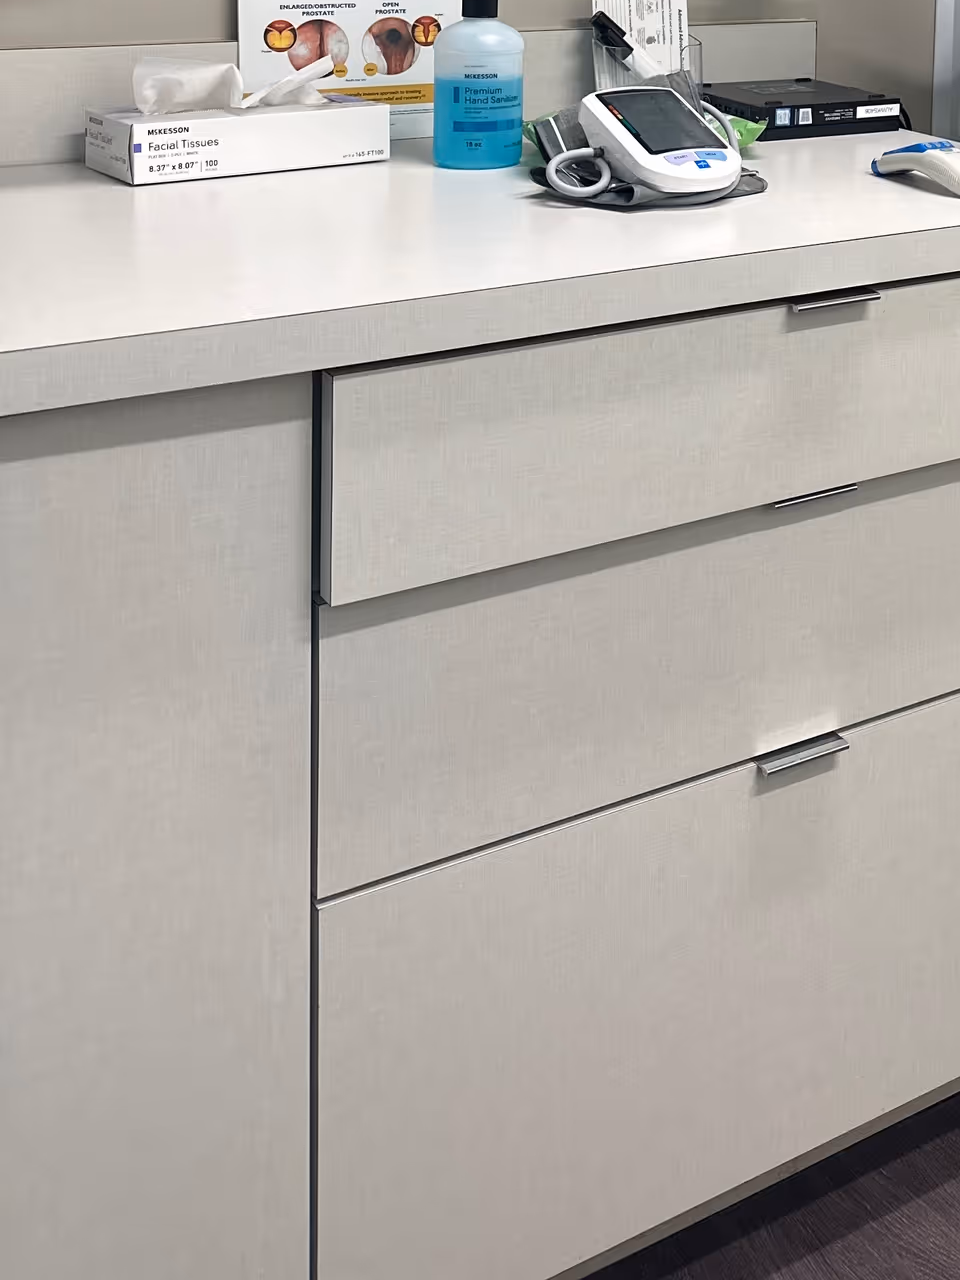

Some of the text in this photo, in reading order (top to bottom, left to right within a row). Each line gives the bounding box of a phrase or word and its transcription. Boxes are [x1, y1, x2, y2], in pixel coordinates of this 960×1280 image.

[464, 96, 488, 104] Hand
[149, 139, 219, 151] Facial Tissues
